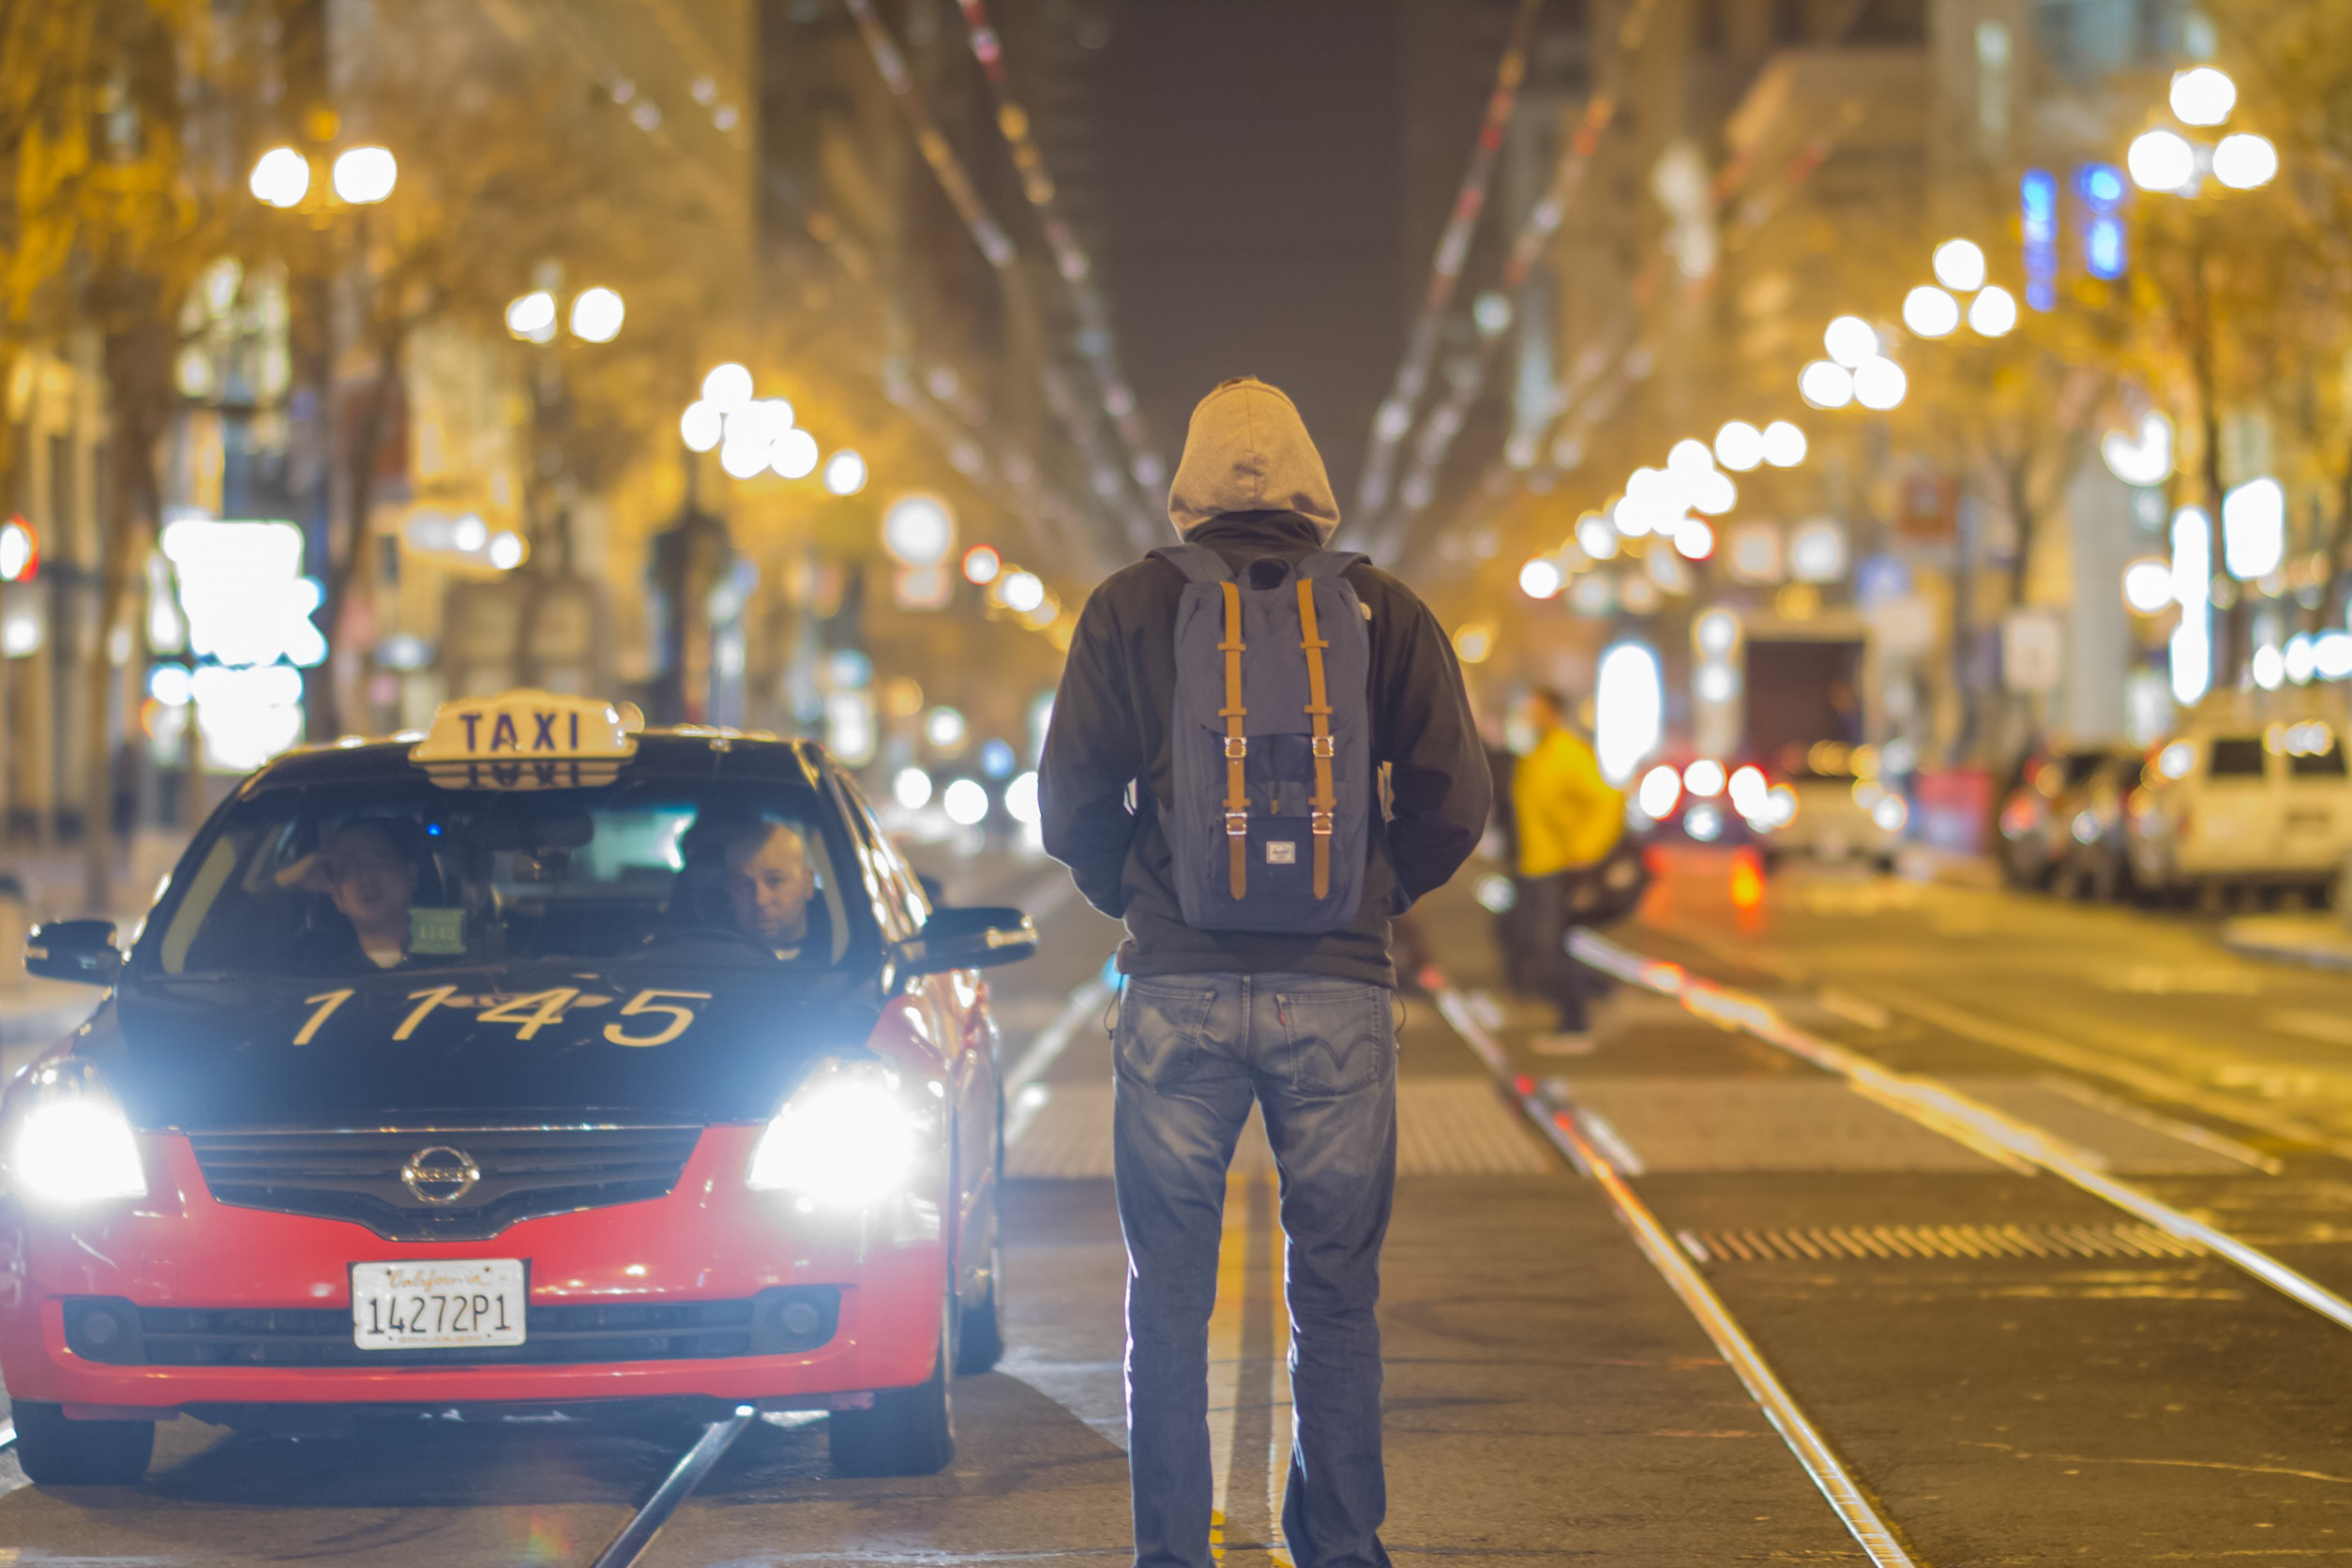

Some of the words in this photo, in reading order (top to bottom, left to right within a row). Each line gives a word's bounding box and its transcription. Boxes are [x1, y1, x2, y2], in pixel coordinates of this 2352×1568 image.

[460, 712, 579, 752] TAXI
[292, 984, 713, 1048] 1145
[367, 1294, 511, 1335] 14272P1
